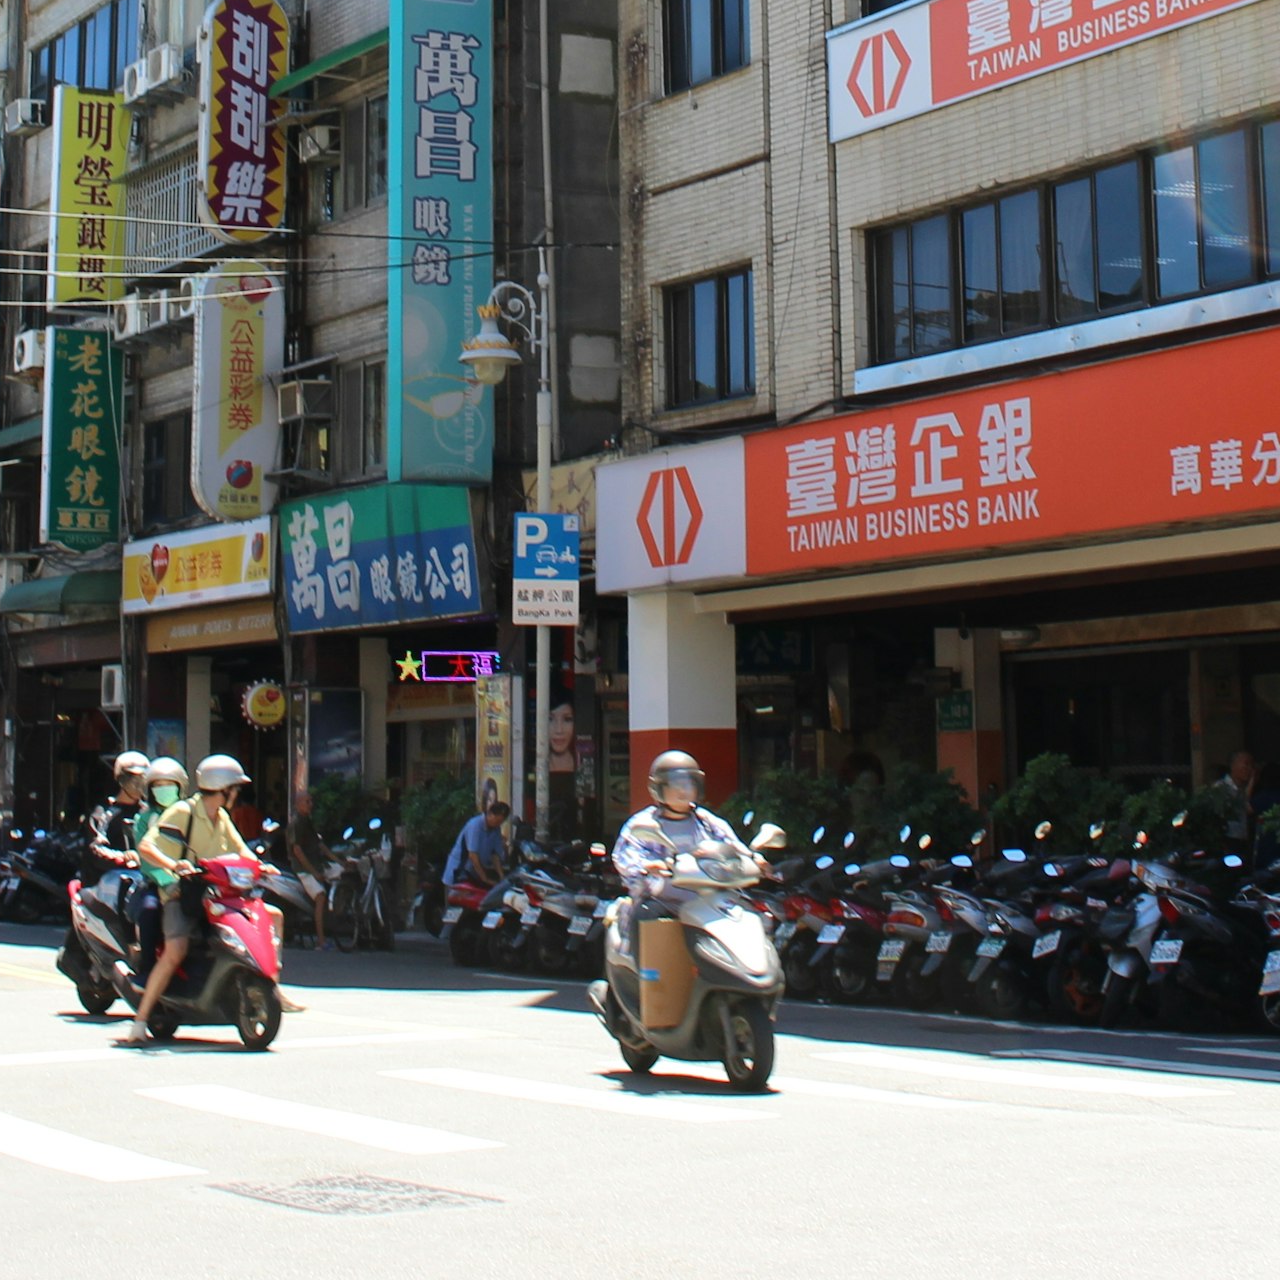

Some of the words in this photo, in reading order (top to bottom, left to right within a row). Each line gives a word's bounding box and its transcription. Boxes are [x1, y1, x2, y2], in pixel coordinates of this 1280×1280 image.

[966, 37, 1042, 83] TAIWAN
[1056, 1, 1152, 54] BUSINESS
[220, 7, 269, 226] 刮刮樂
[64, 335, 106, 507] 老花眼鏡
[228, 319, 256, 431] 公益彩券
[784, 396, 1038, 518] 臺灣企銀
[516, 517, 548, 558] P
[786, 516, 860, 554] TAIWAN
[864, 497, 971, 544] BUSINESS
[975, 487, 1040, 528] BANK
[554, 608, 574, 618] Park
